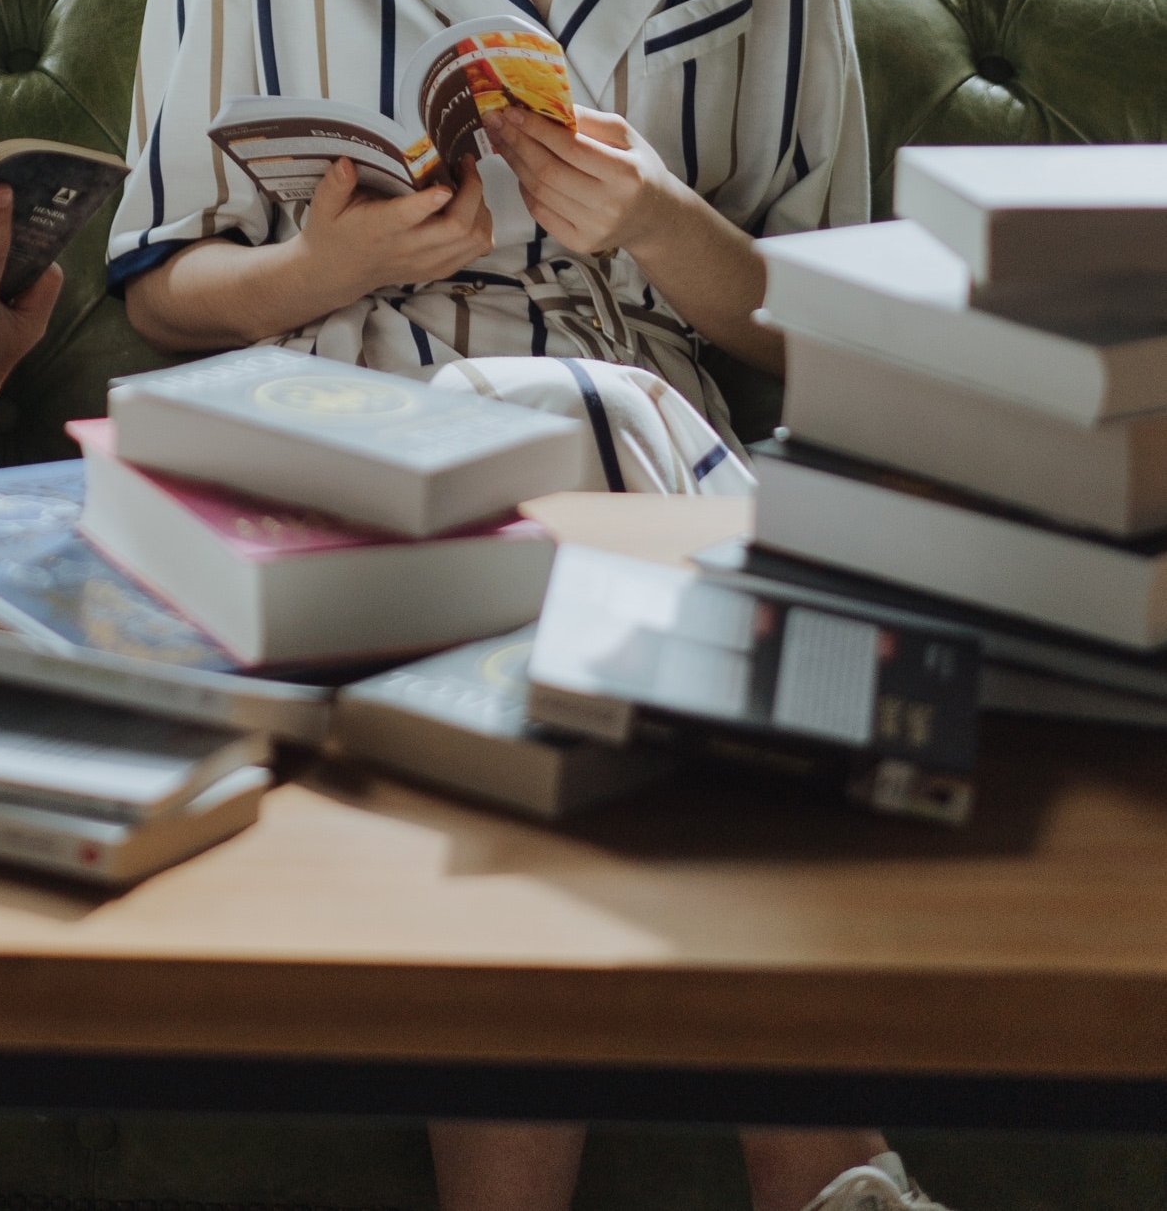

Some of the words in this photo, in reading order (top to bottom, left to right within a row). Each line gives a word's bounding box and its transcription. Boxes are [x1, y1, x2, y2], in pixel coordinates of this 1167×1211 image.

[310, 128, 384, 153] Bel-Ami
[33, 205, 66, 221] HENRIK
[29, 215, 56, 228] IBSEN
